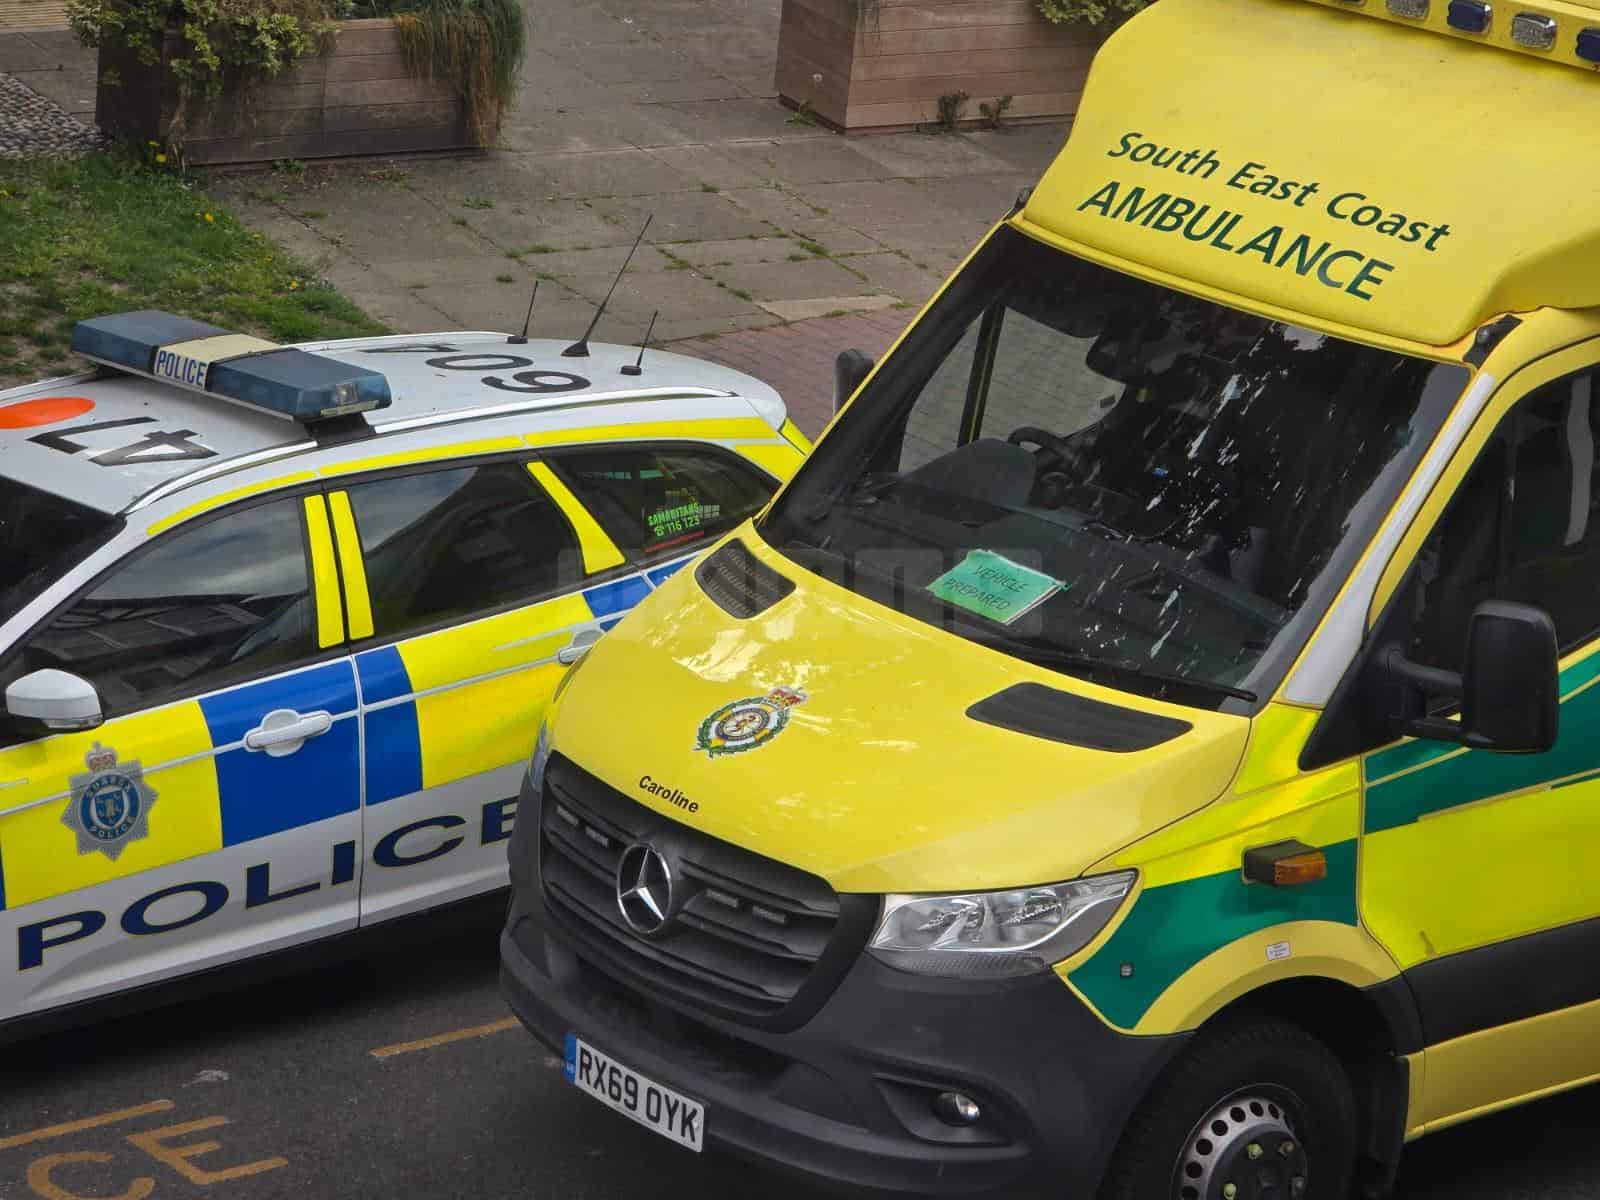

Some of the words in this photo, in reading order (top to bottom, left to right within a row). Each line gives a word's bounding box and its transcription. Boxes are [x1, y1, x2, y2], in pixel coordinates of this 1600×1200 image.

[1106, 131, 1221, 179] South
[1226, 161, 1320, 208] East
[1326, 191, 1451, 252] Coast
[1076, 180, 1395, 301] AMBULANCE
[154, 350, 207, 387] POLICE
[944, 577, 1011, 610] PREPARED
[975, 565, 1027, 593] VEHICLE
[638, 775, 699, 813] Caroline
[579, 1047, 639, 1112] RX69
[646, 1086, 698, 1142] OYK
